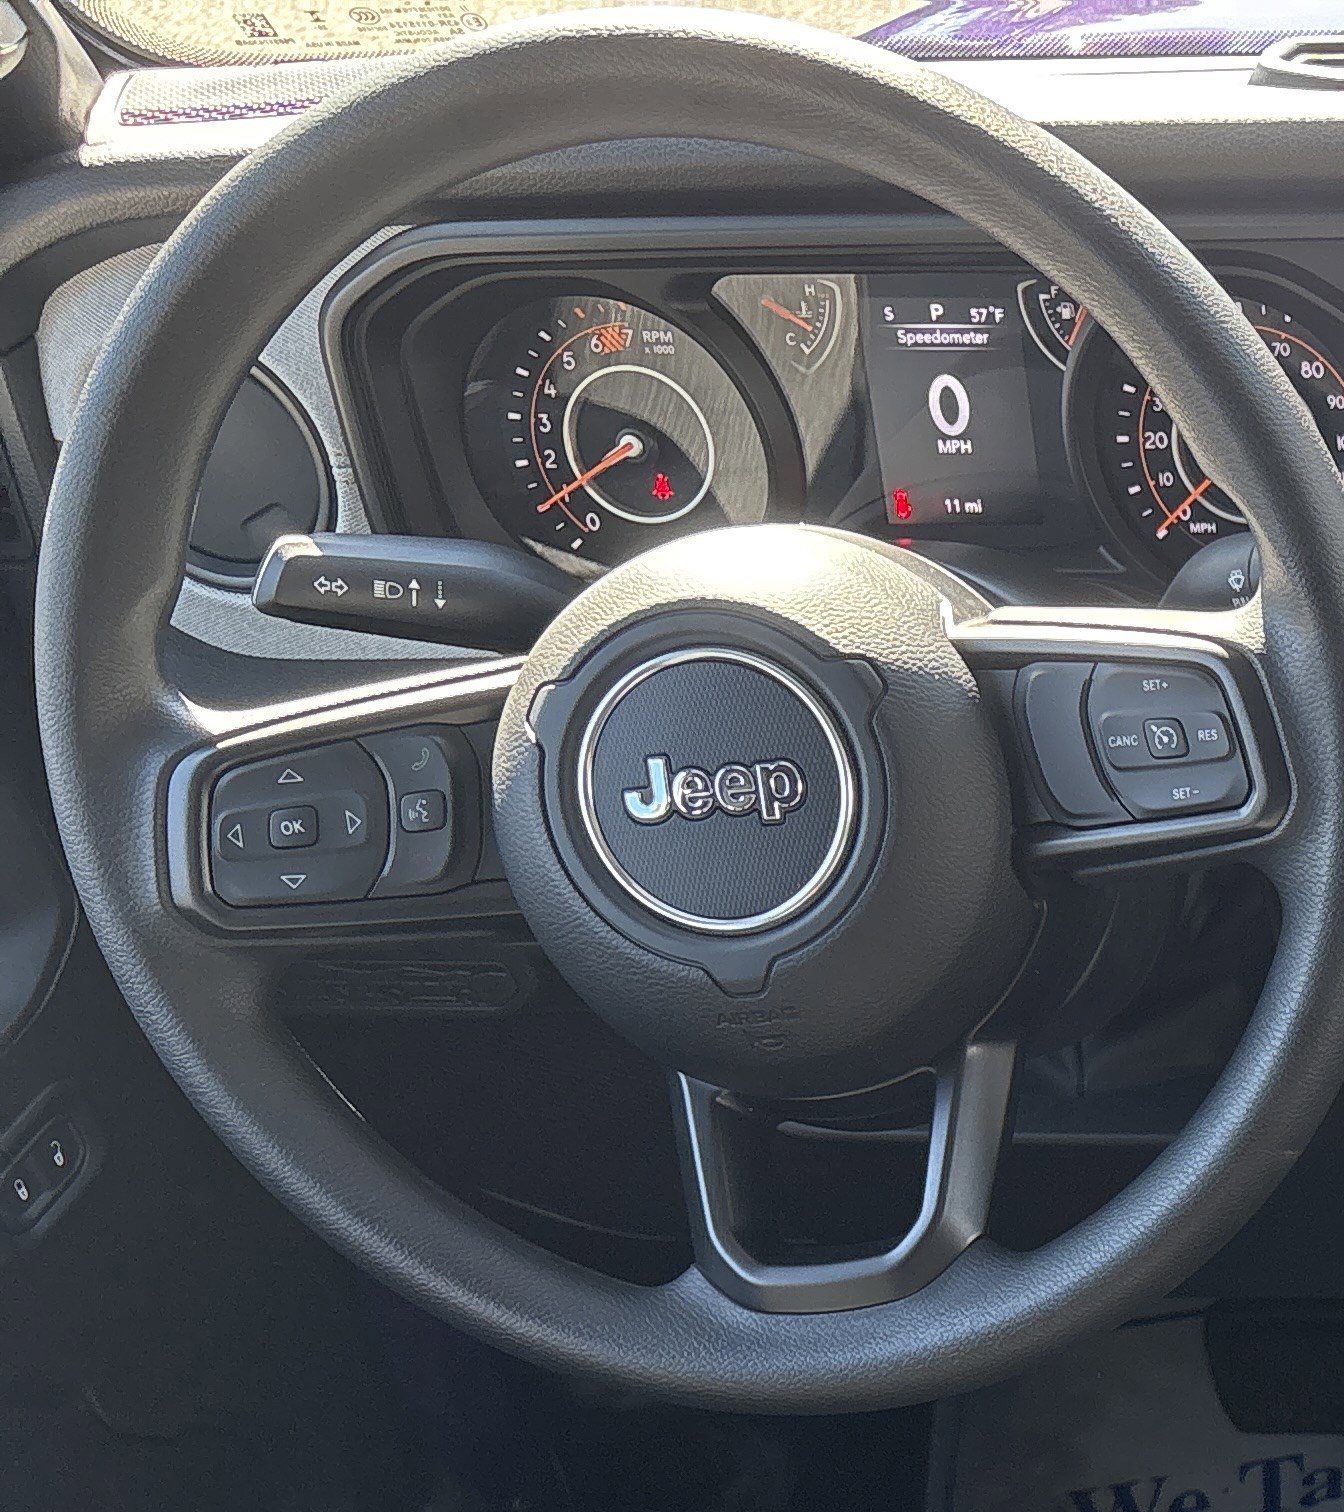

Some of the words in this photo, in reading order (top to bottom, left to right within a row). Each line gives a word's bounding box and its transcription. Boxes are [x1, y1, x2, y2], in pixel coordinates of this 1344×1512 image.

[804, 284, 815, 296] H
[1050, 285, 1059, 299] F
[930, 304, 944, 321] P
[970, 307, 1005, 324] 57°F
[591, 337, 602, 353] 6
[621, 328, 634, 347] 7
[642, 330, 673, 344] RPM
[785, 333, 797, 346] C
[896, 329, 990, 347] Speedometer
[652, 344, 675, 355] 1000
[1271, 341, 1291, 358] 70
[562, 352, 576, 371] 5
[1300, 361, 1325, 379] 80
[543, 379, 558, 399] 4
[928, 373, 971, 436] 0
[1327, 394, 1344, 410] 90
[538, 413, 553, 433] 3
[937, 439, 973, 455] MPH
[1144, 432, 1168, 450] 20
[543, 449, 558, 469] 2
[1158, 471, 1174, 487] 10
[945, 499, 961, 514] 11
[964, 498, 983, 515] mi
[1180, 506, 1191, 523] 0
[585, 512, 601, 531] 0
[1189, 522, 1217, 535] MPH
[1107, 734, 1139, 748] CANC
[1197, 729, 1218, 742] RES
[622, 755, 806, 826] Jeep
[279, 818, 305, 837] OK
